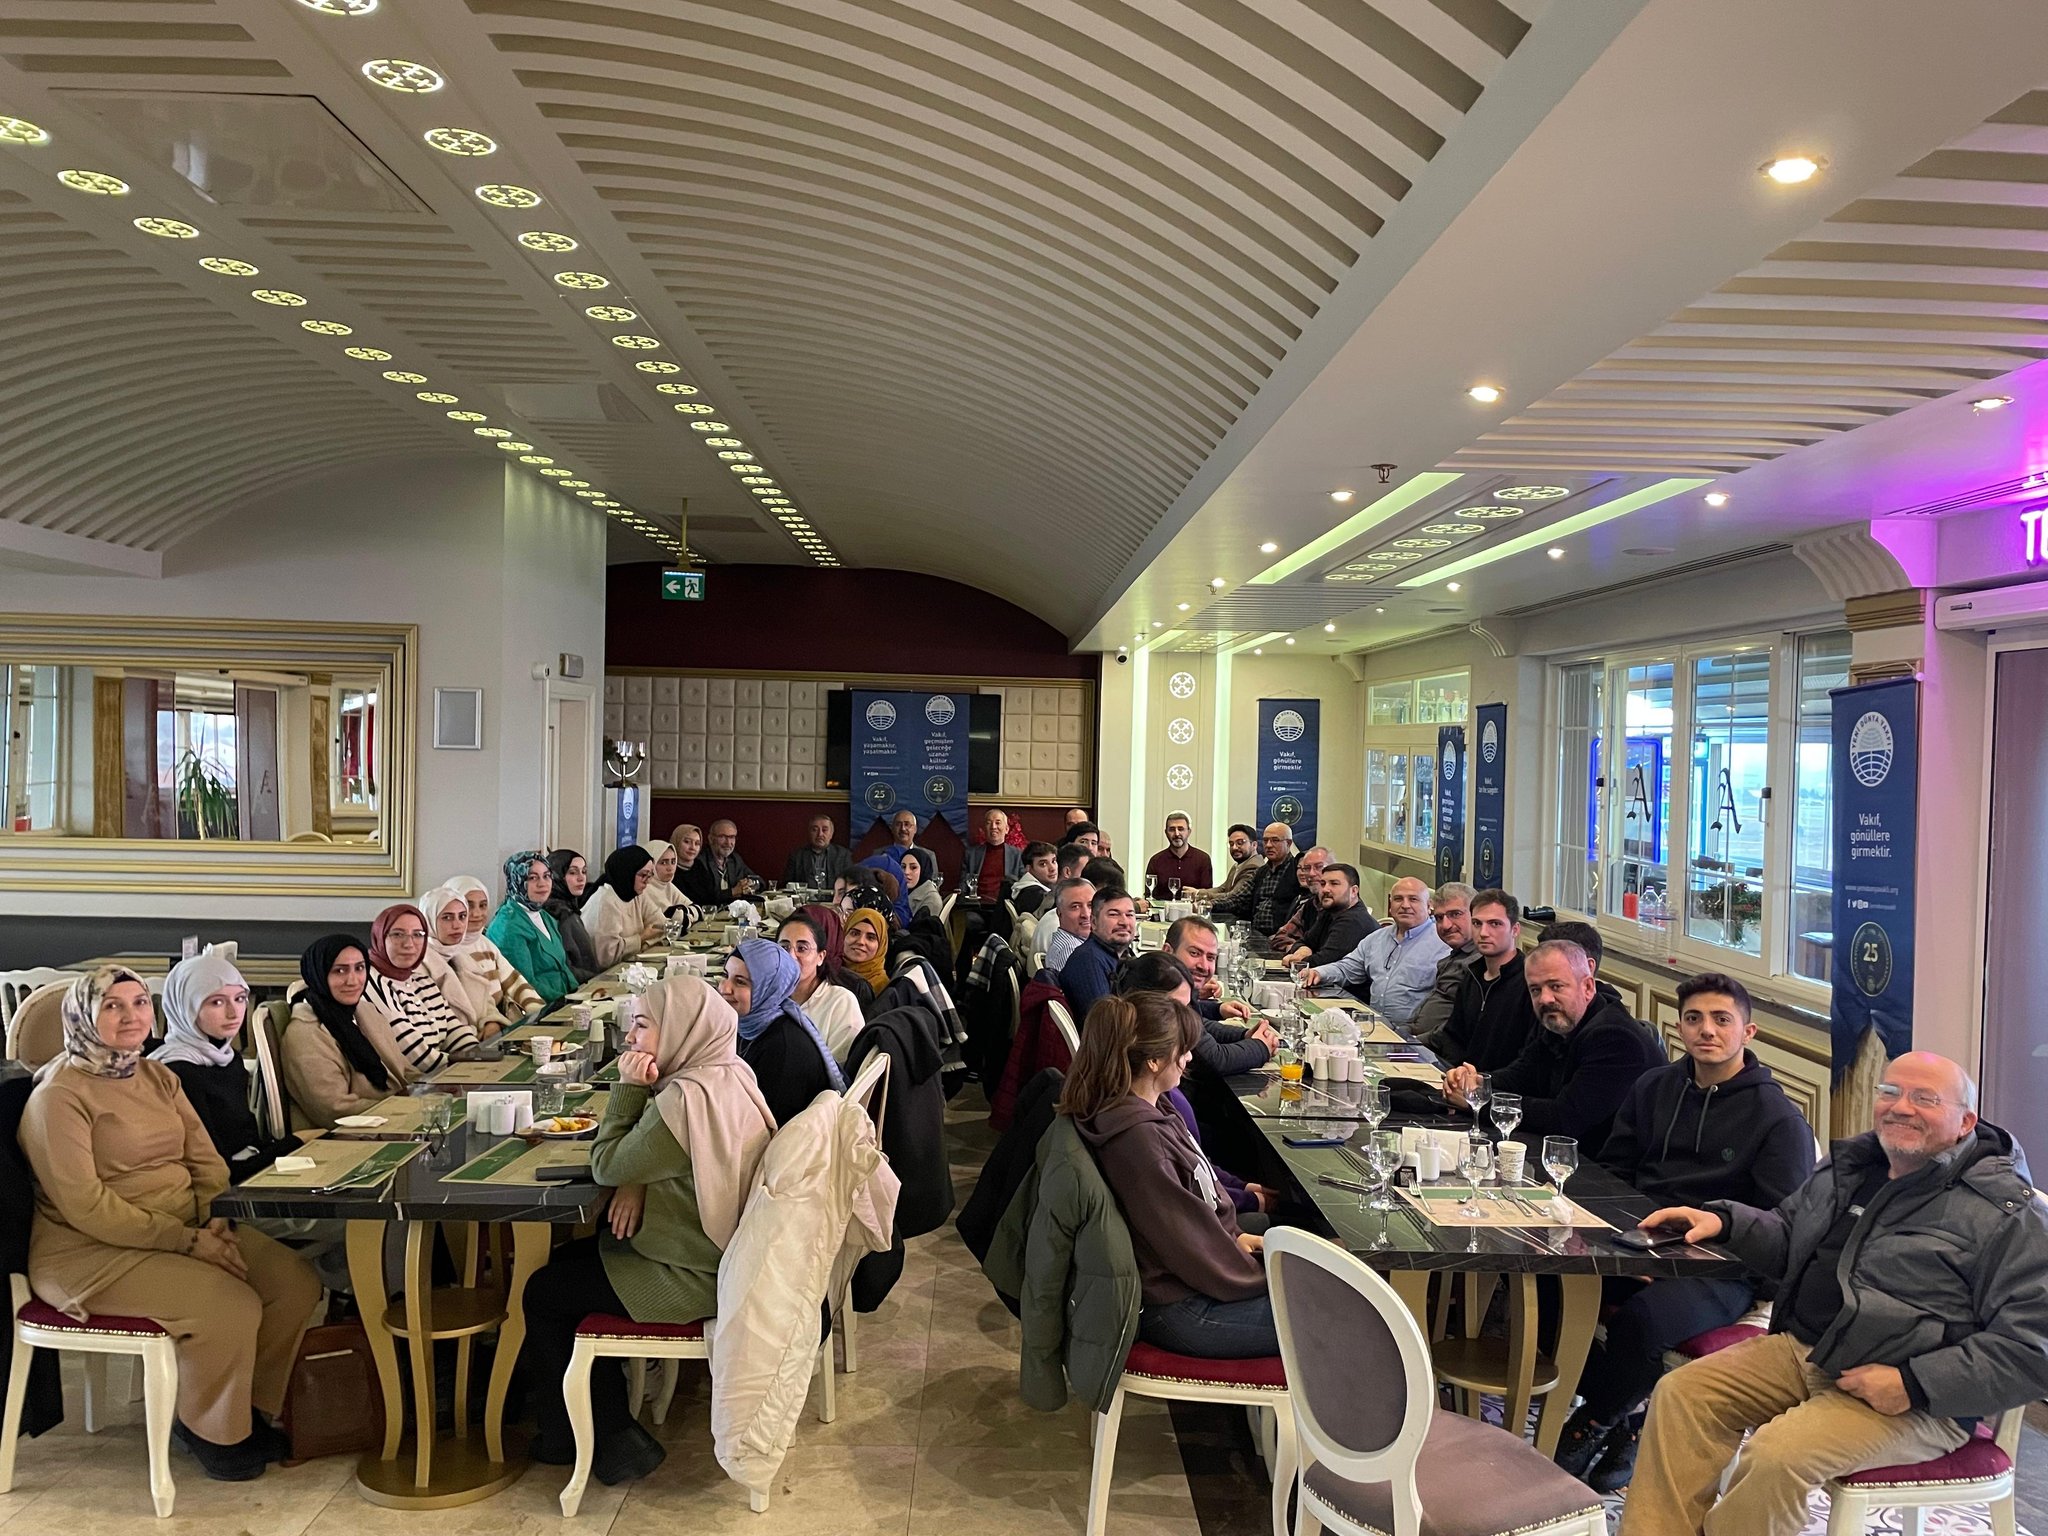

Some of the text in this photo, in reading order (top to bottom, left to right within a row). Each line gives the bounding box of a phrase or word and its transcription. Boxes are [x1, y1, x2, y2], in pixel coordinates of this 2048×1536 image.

[874, 790, 886, 799] 25
[933, 783, 944, 792] 25
[1280, 803, 1292, 813] 25
[1858, 813, 1882, 827] Vakıf,
[1850, 829, 1891, 845] gönüllere
[1851, 844, 1892, 860] girmektir.
[1863, 942, 1879, 963] 25
